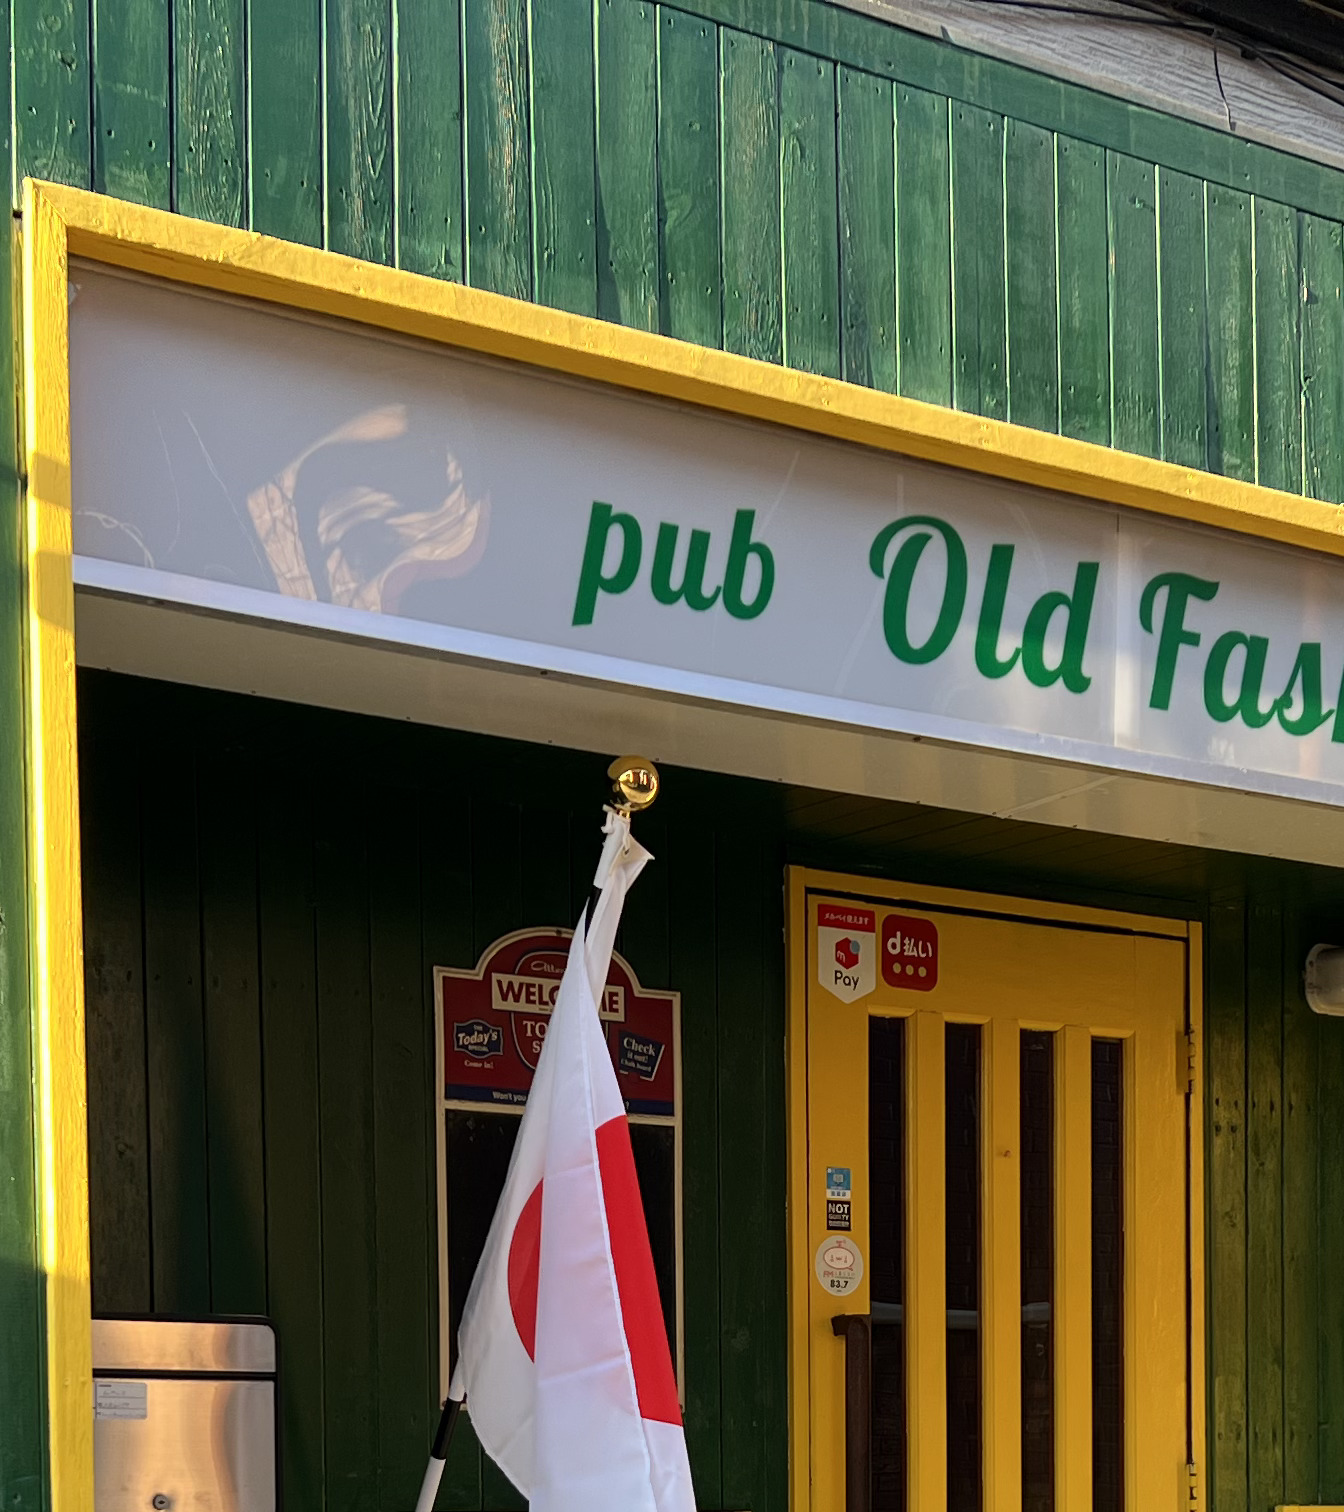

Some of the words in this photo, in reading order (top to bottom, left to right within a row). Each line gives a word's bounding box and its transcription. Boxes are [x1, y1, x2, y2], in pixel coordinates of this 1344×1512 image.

[572, 502, 775, 626] pub
[869, 516, 1099, 694] Old
[887, 930, 933, 958] d払い
[834, 969, 860, 991] Pay
[496, 979, 619, 1013] WELCE
[457, 1028, 498, 1046] Today's
[623, 1036, 656, 1057] Check
[828, 1203, 850, 1214] NOT
[830, 1279, 849, 1289] 83.7
